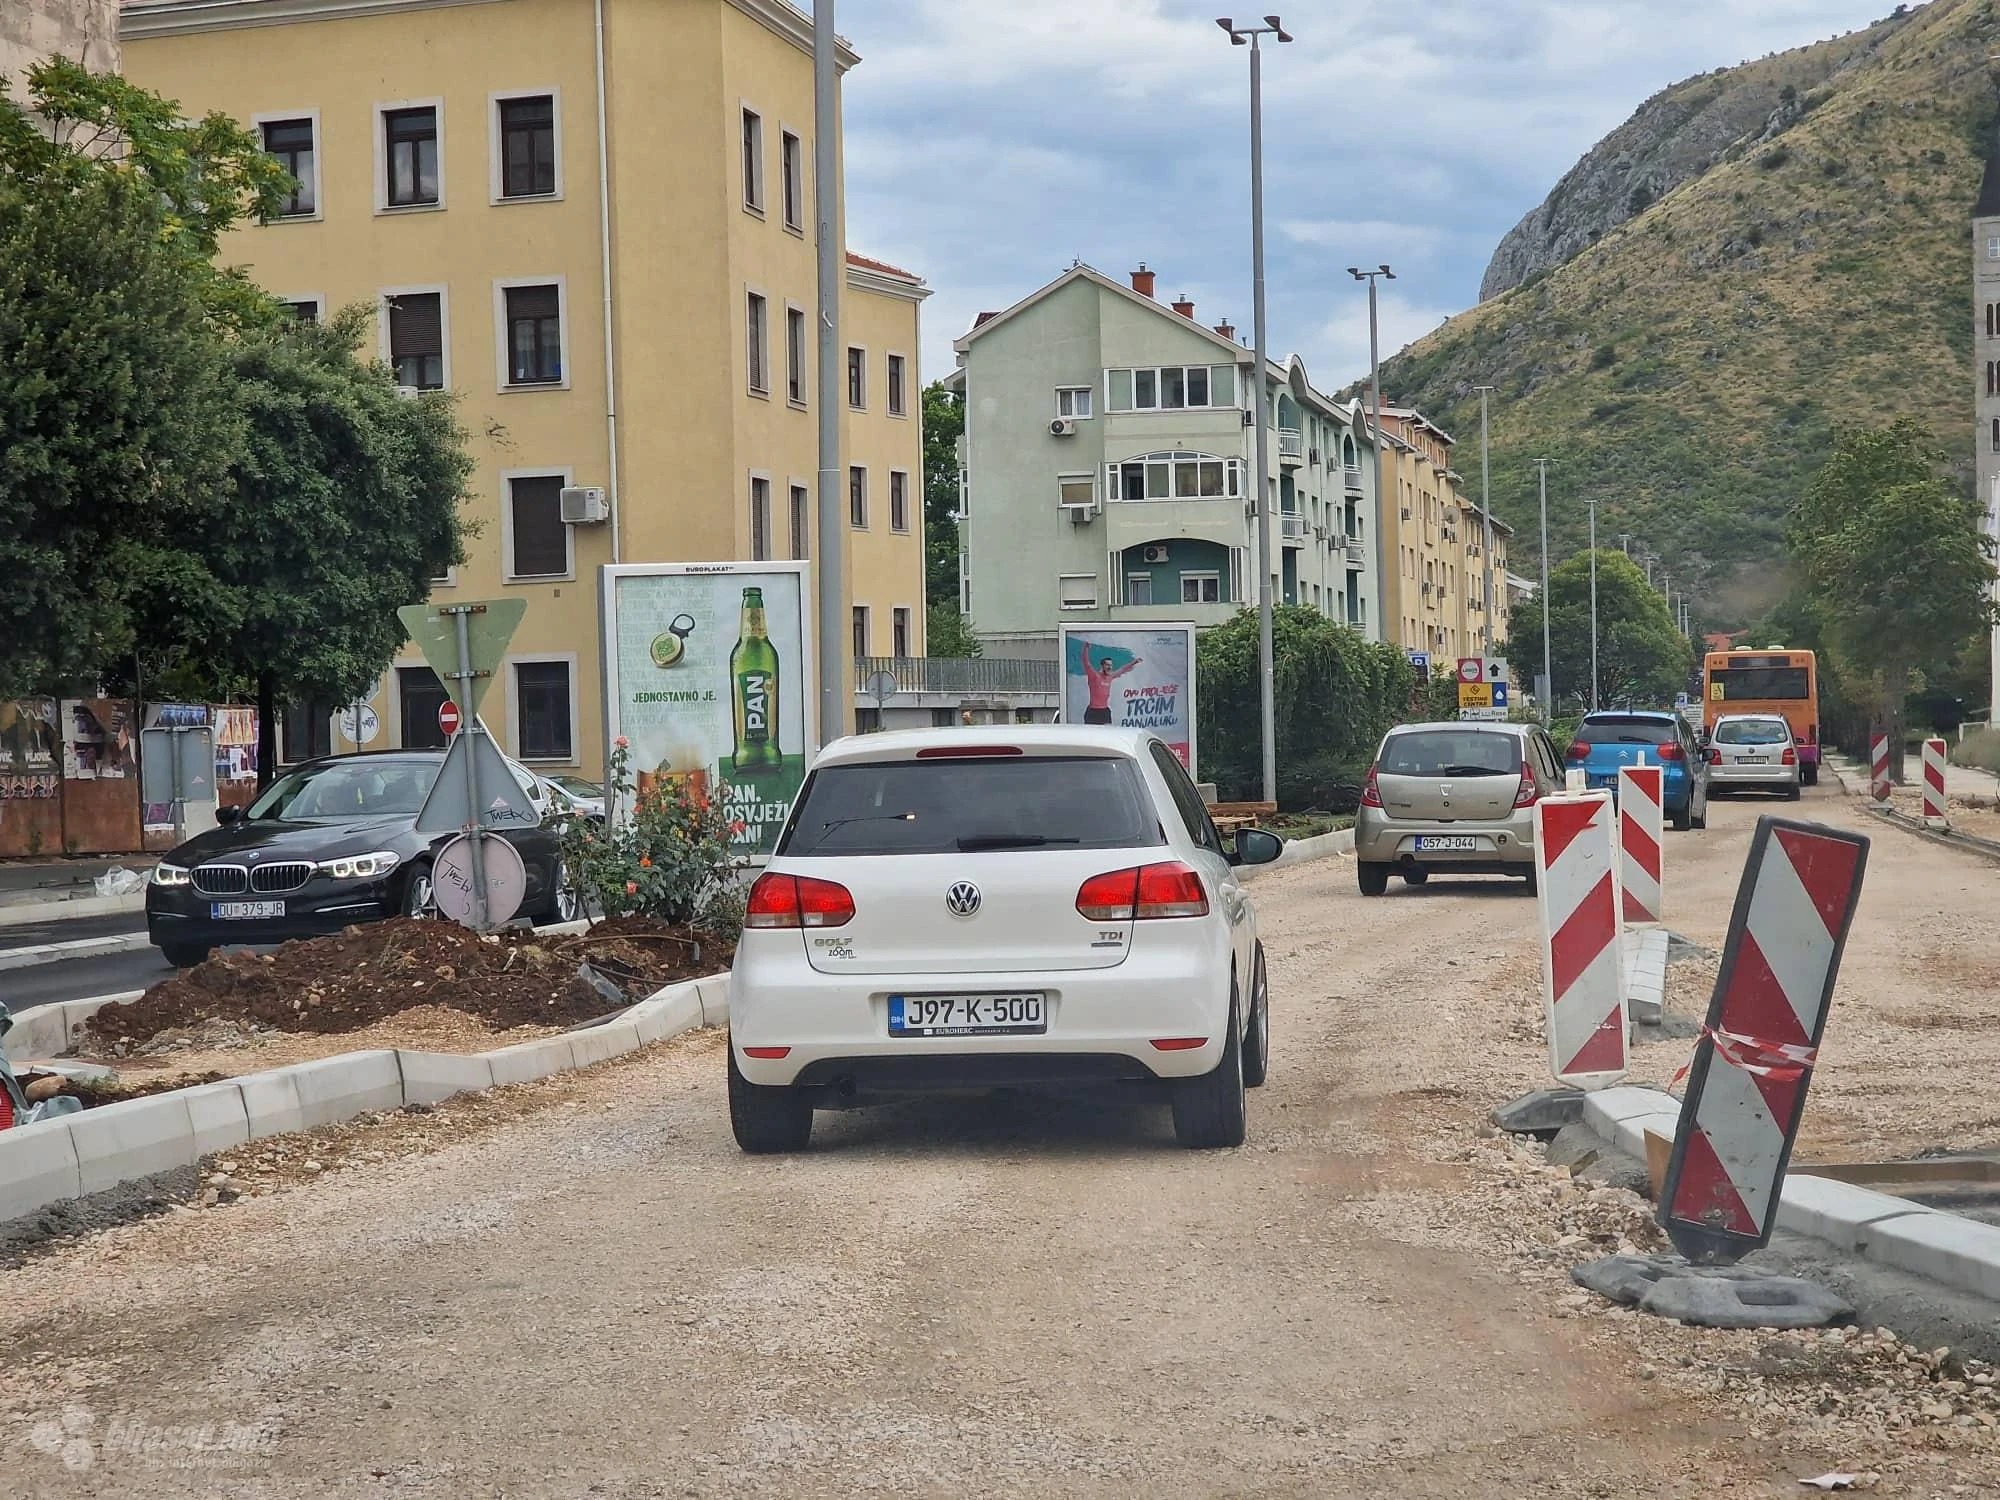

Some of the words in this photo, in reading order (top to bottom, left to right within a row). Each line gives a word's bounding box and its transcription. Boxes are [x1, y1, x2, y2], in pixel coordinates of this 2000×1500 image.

[632, 691, 699, 703] JEDNOSTAVNO
[702, 690, 717, 702] JE.
[746, 676, 765, 729] PAN
[723, 784, 762, 804] PAN.
[722, 800, 789, 823] OSVJEŽI
[726, 824, 762, 844] AN!
[1423, 837, 1473, 848] 057-J-044
[219, 904, 233, 917] DU
[814, 937, 853, 947] GOLF
[1099, 931, 1123, 941] TDI
[908, 998, 1040, 1025] J97-K-500
